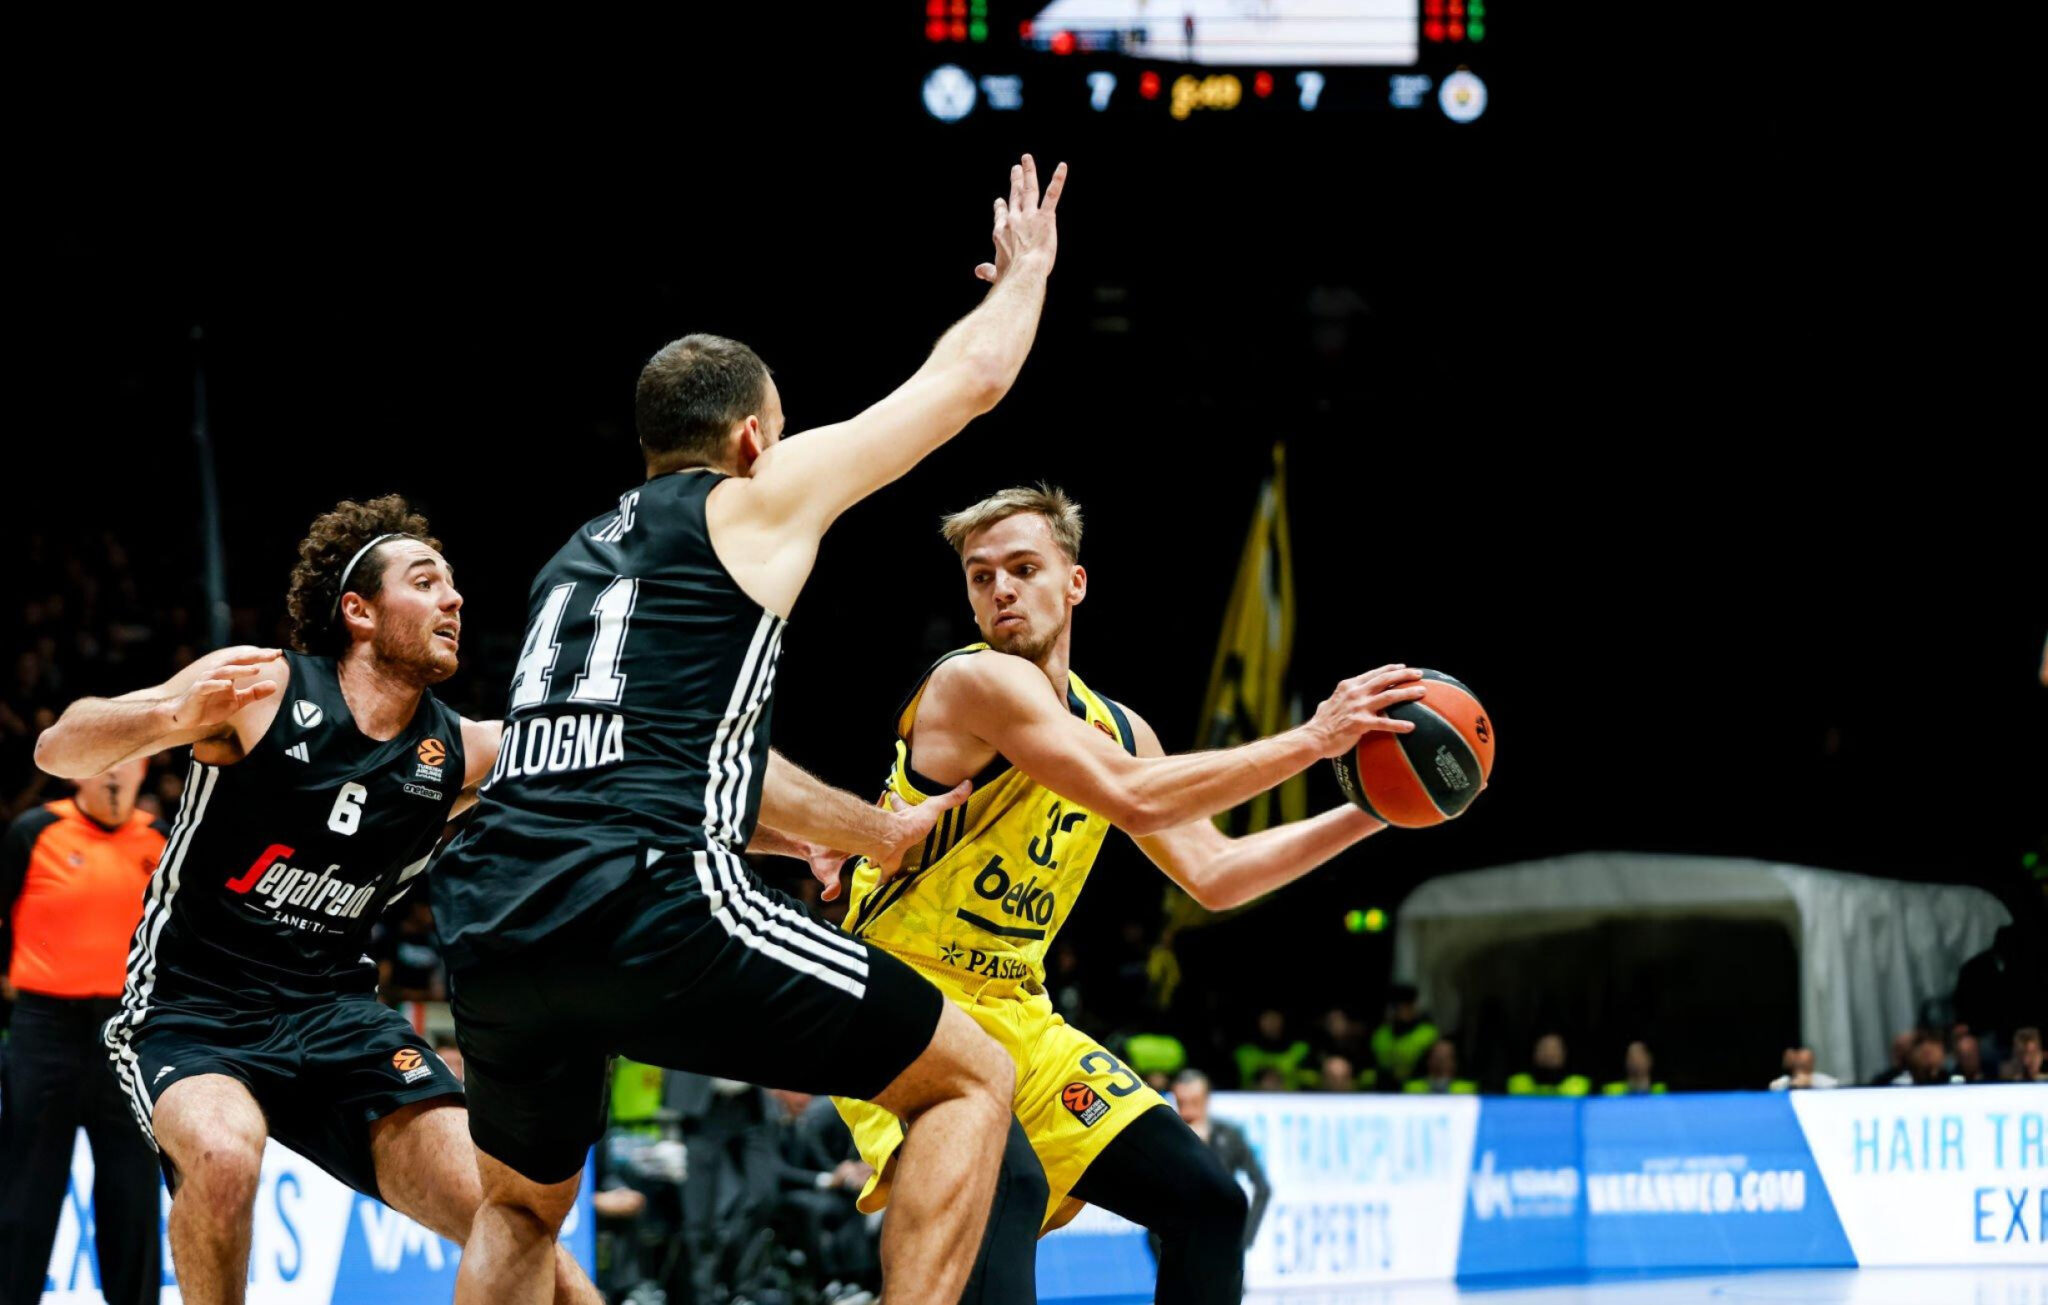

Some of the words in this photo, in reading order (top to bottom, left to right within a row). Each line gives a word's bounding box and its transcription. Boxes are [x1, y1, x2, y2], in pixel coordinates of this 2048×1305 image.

[1087, 71, 1117, 112] 7
[1296, 71, 1325, 112] 7
[510, 575, 639, 712] 41
[480, 713, 625, 791] OLOGNA
[327, 781, 368, 836] 6
[973, 854, 1053, 926] beko
[1080, 1051, 1142, 1097] 3
[1853, 1114, 1965, 1174] HAIR
